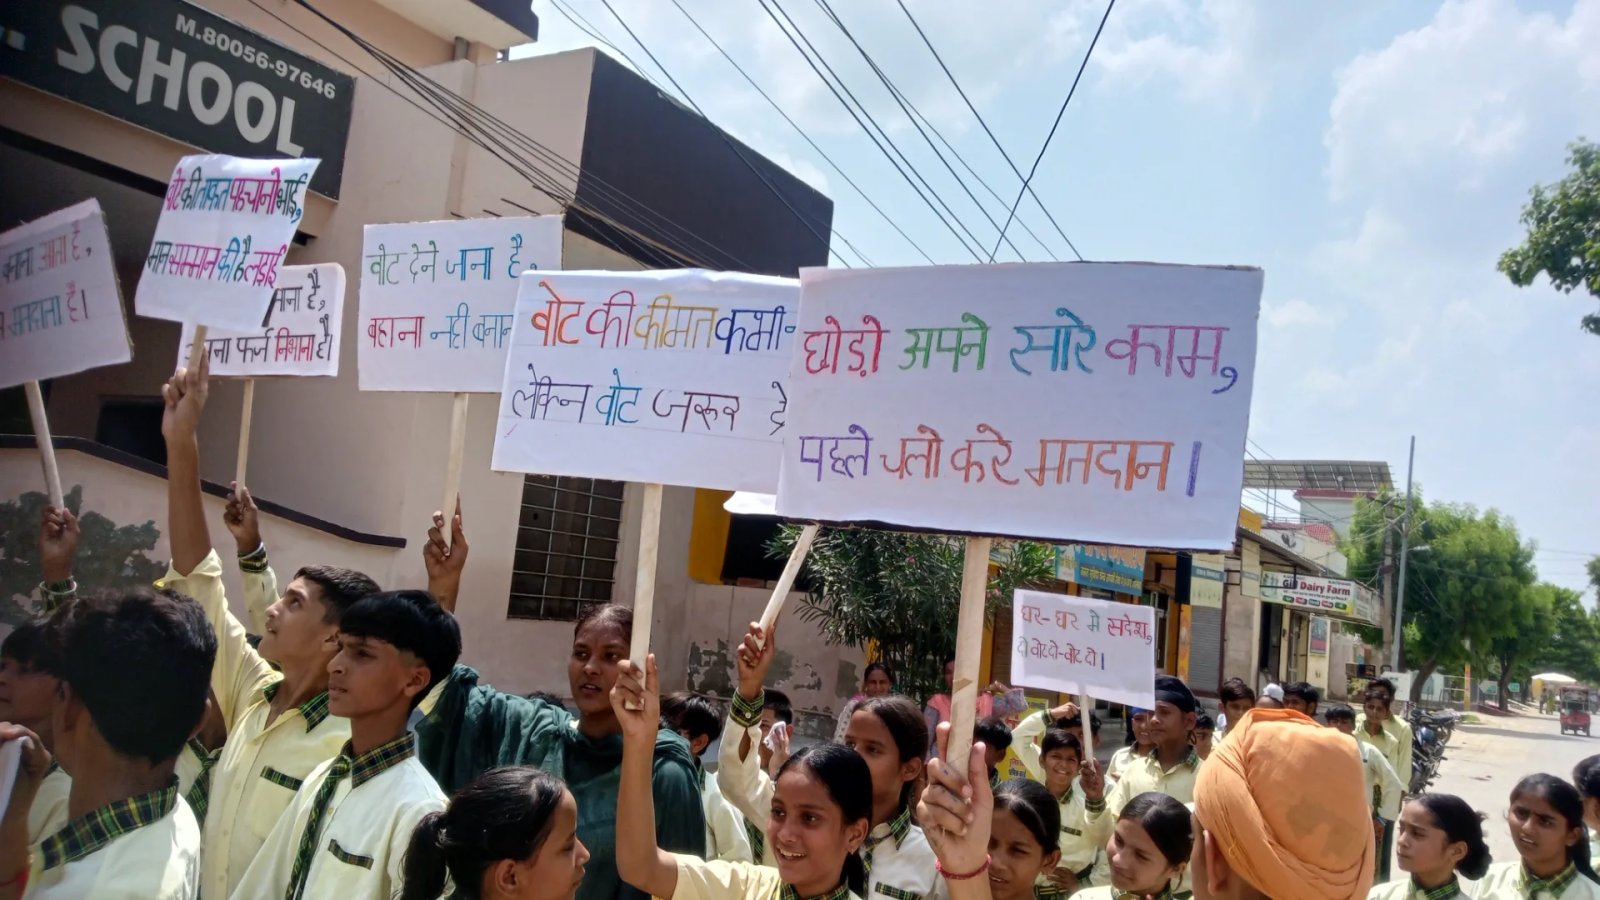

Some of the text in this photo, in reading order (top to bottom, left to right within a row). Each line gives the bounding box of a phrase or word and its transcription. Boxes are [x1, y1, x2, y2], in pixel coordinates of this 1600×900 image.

[57, 4, 304, 158] SCHOOL
[175, 14, 336, 100] M.80056-97646
[181, 166, 202, 210] की
[230, 167, 281, 215] पहचानो
[169, 243, 222, 280] सम्मान
[218, 237, 241, 283] की
[234, 235, 251, 282] है
[365, 244, 408, 286] वोट
[409, 240, 439, 283] देने
[367, 302, 513, 349] बहाना नही बनान
[531, 281, 786, 355] वोट की कीमत कभी
[898, 311, 991, 374] अपने
[1009, 307, 1097, 376] सारे
[596, 368, 643, 426] वोट
[799, 423, 873, 482] पहले
[880, 424, 944, 481] चलो
[950, 423, 1020, 487] करे
[1300, 582, 1325, 594] Dairy
[1327, 585, 1351, 597] Farm
